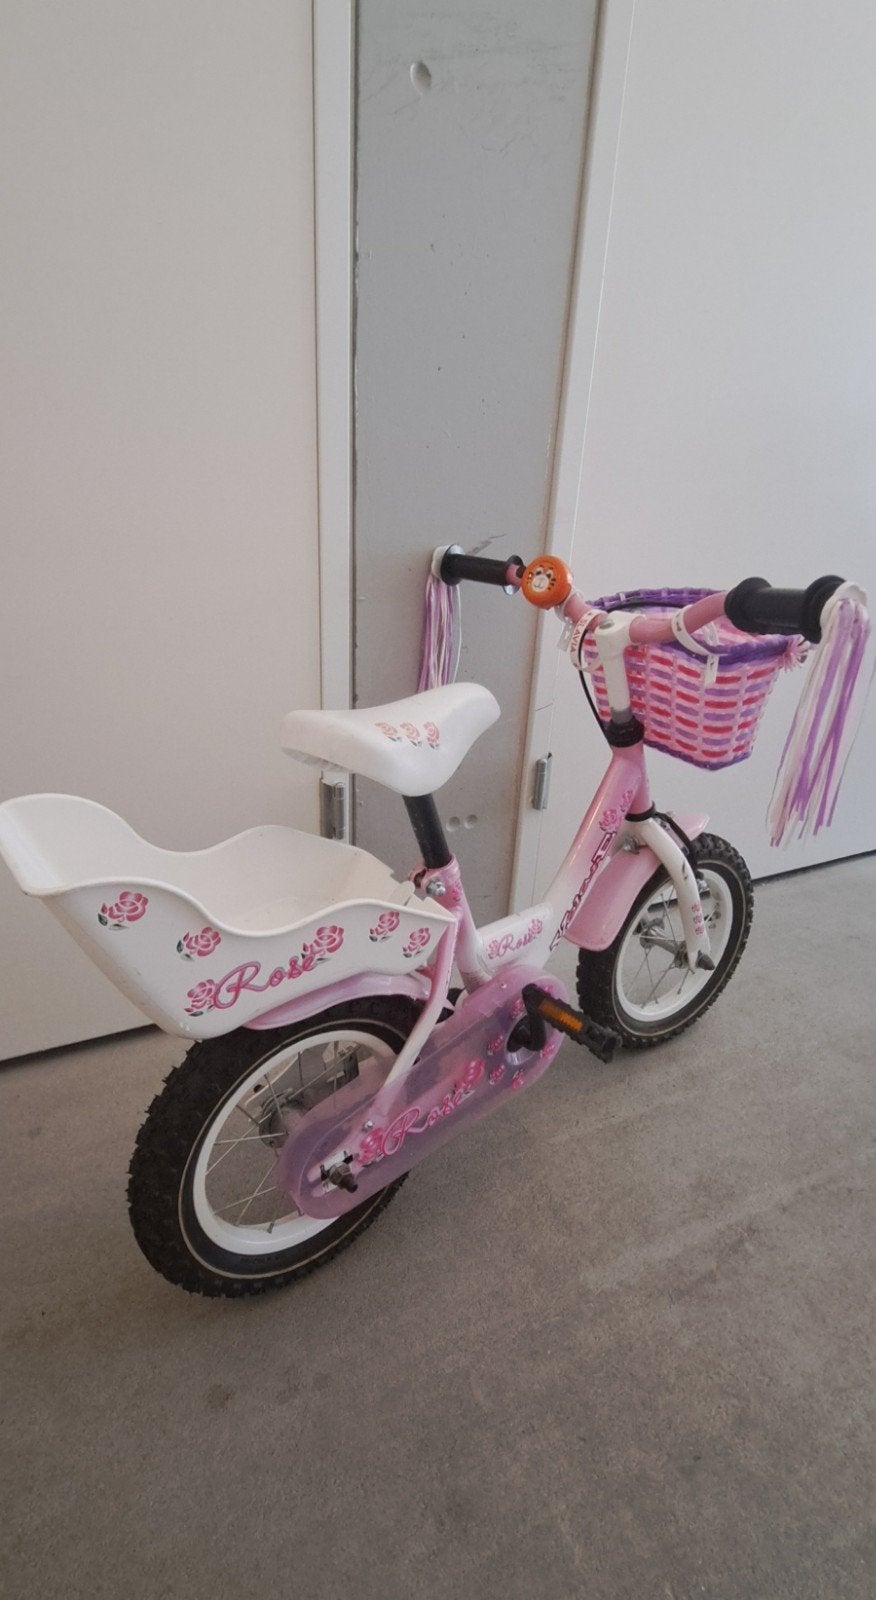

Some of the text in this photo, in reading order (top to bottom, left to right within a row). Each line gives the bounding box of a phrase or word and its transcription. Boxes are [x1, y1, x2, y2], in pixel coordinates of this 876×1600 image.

[498, 929, 534, 957] Rose
[213, 954, 316, 1010] Rose
[382, 1087, 466, 1156] Rose
